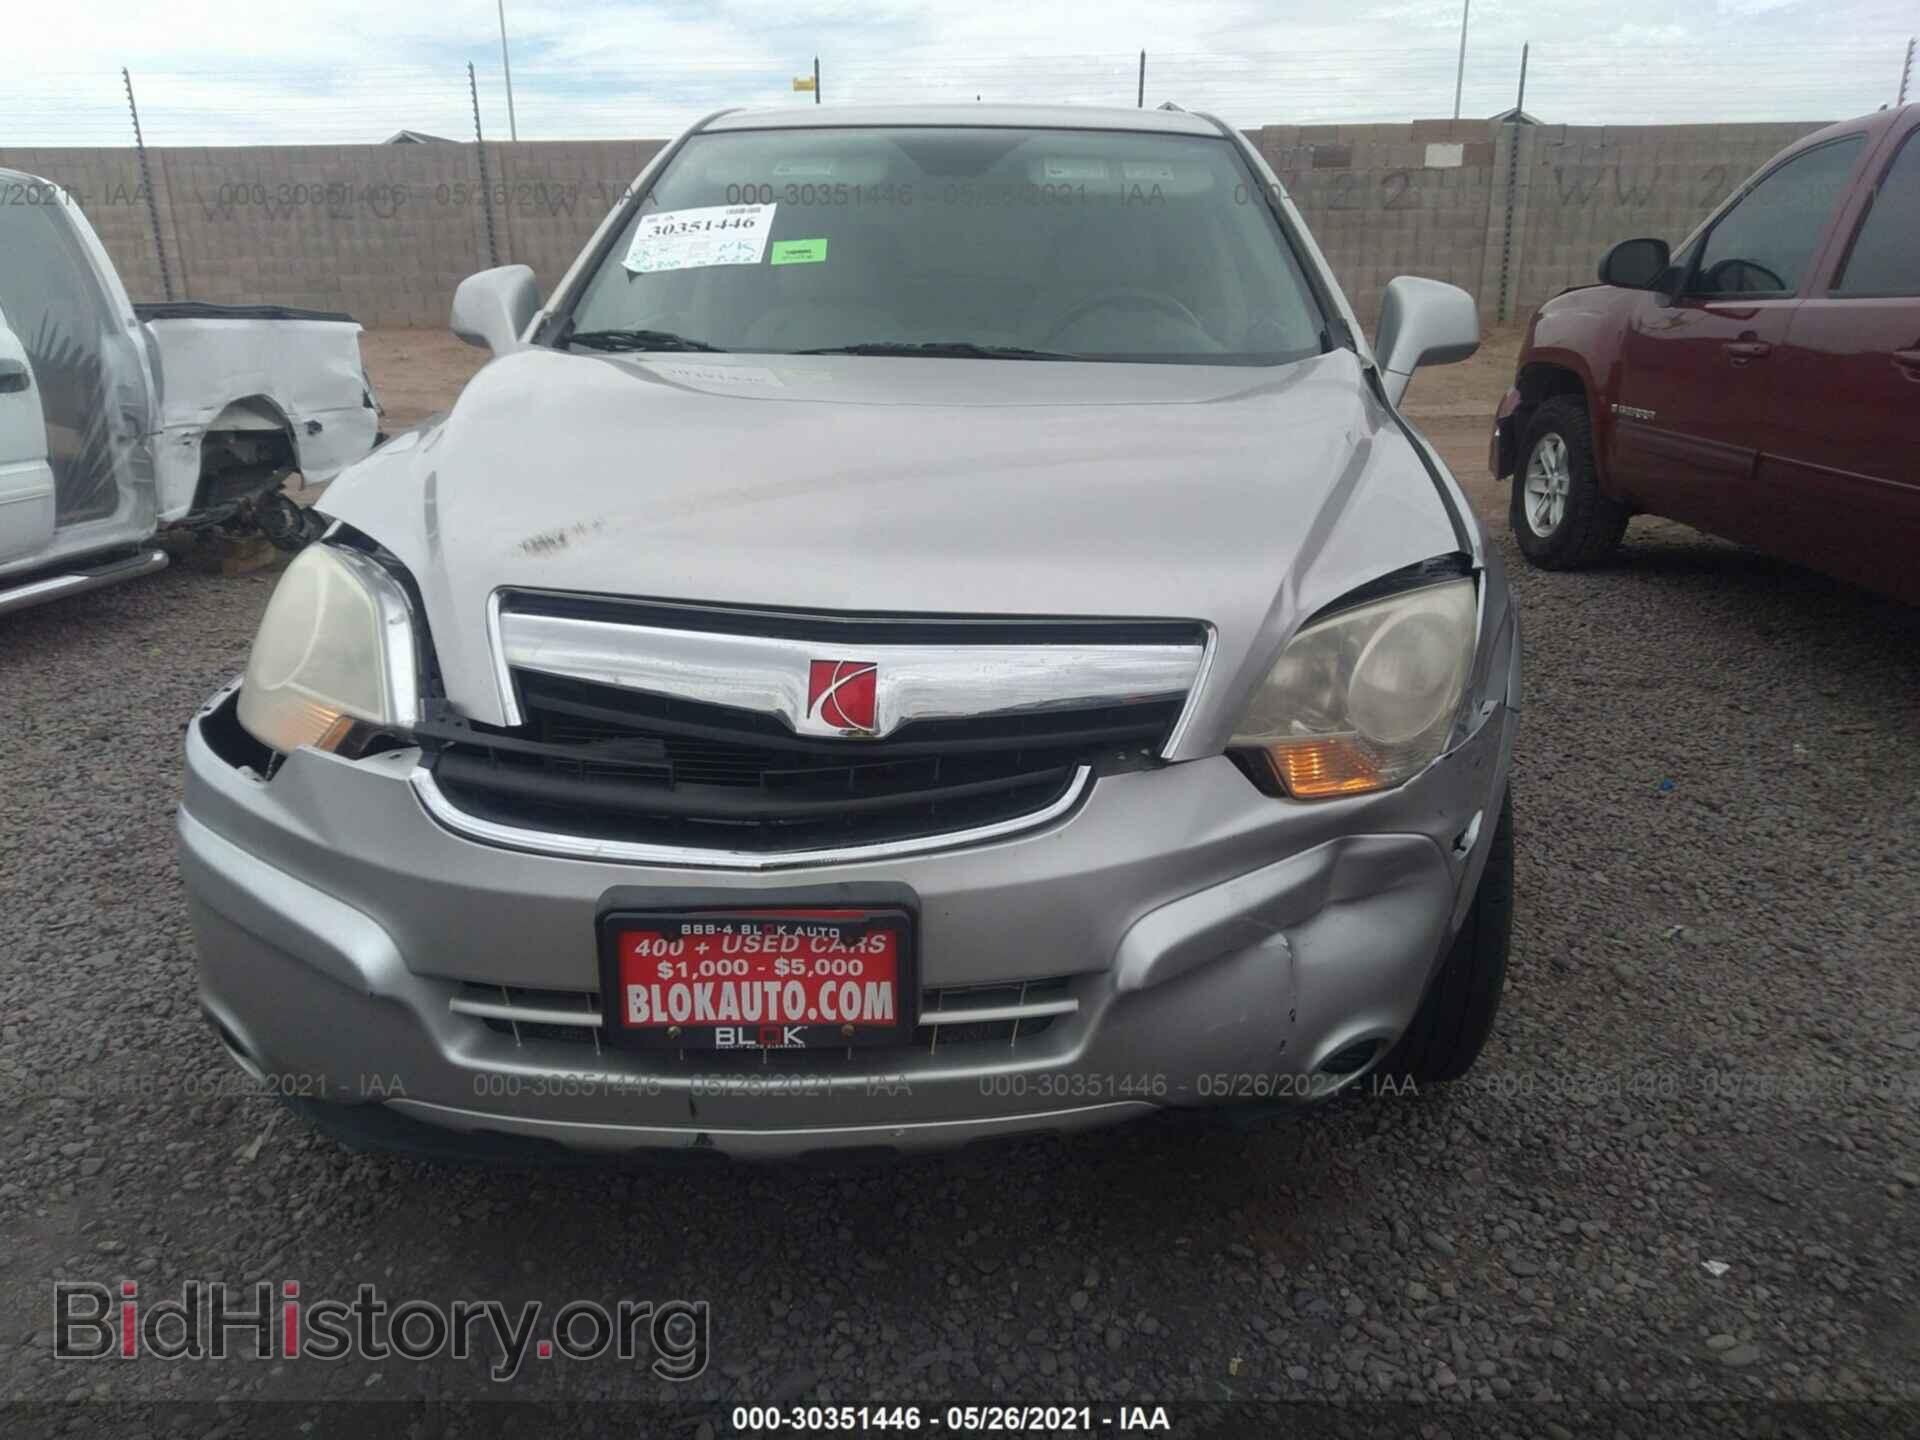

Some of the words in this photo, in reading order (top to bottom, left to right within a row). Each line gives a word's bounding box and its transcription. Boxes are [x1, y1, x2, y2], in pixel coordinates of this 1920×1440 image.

[647, 217, 756, 238] 30351446
[794, 926, 841, 938] AUTO
[635, 938, 684, 956] 400
[722, 934, 800, 953] USED
[811, 934, 887, 954] CARS
[657, 959, 749, 980] $1,000
[774, 957, 864, 978] $5,000
[626, 980, 895, 1024] BLOKAUTO.COM
[715, 1026, 805, 1045] BLOK
